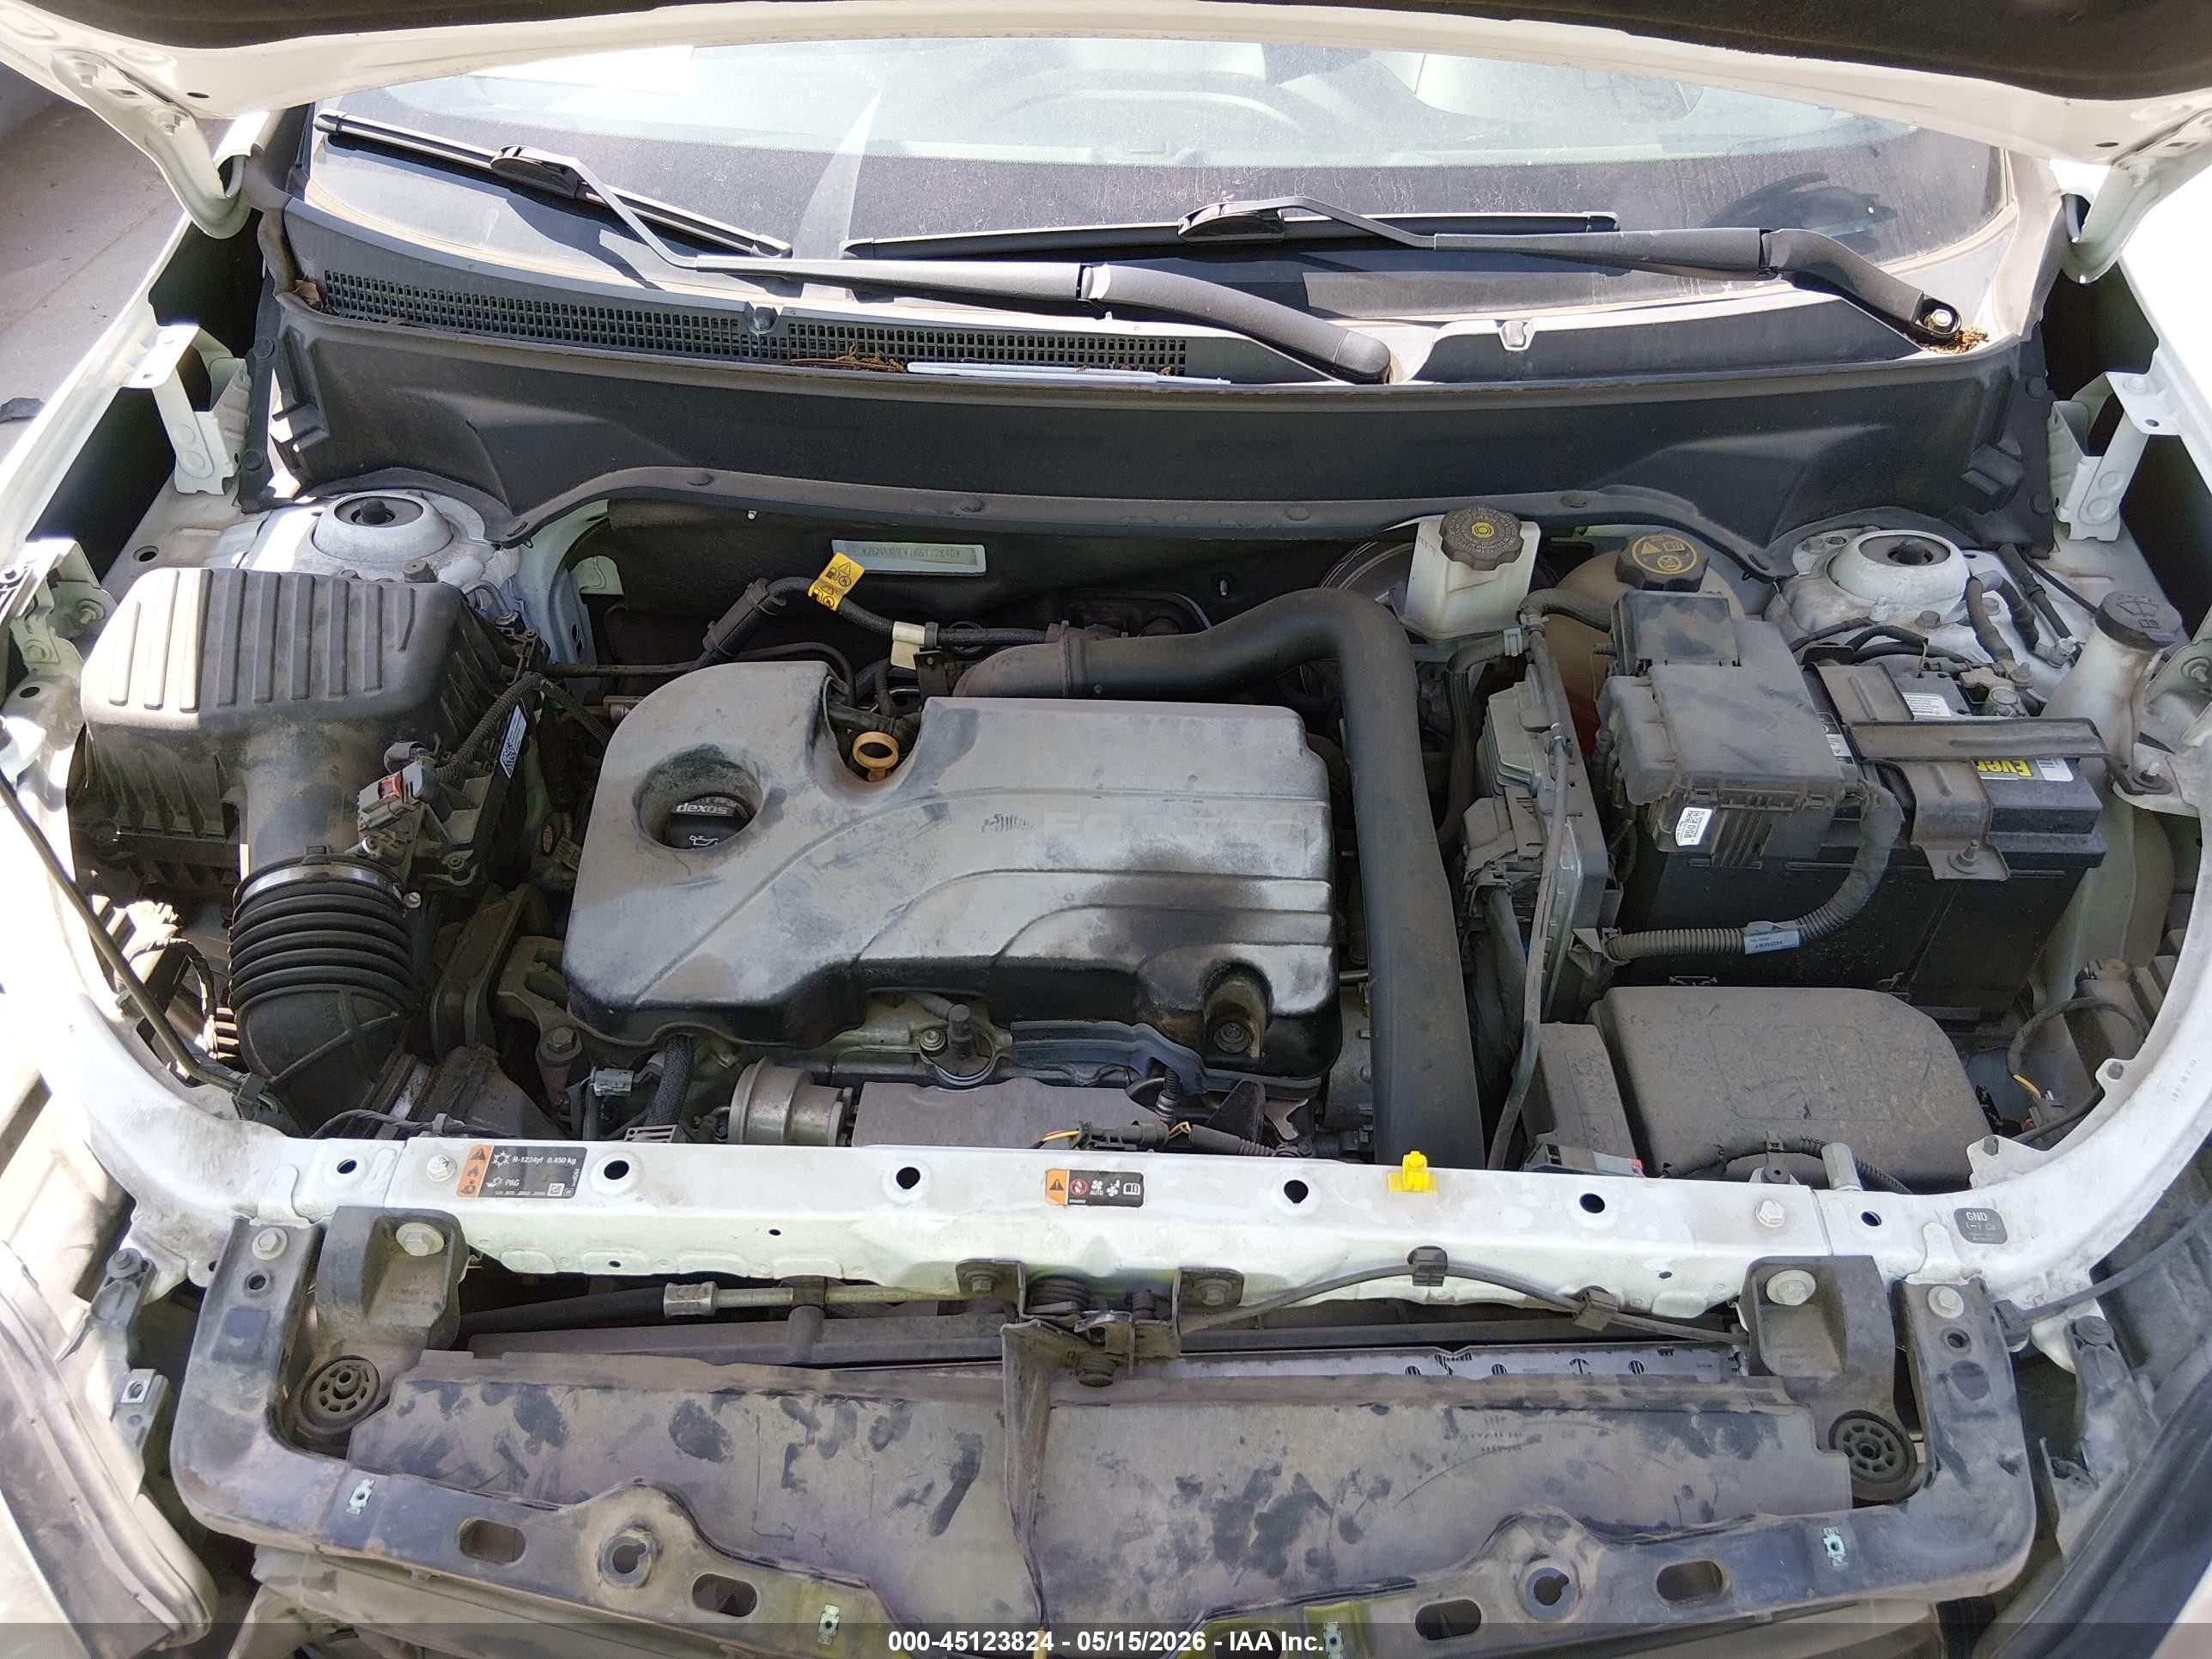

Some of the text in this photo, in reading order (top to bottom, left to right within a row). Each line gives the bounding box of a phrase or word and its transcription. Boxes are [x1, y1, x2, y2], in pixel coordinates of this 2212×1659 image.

[676, 802, 728, 815] dexos
[512, 1156, 544, 1164] R-1234yf
[567, 1156, 578, 1165] kg
[505, 1178, 520, 1187] PAG
[1966, 1212, 1988, 1222] GND
